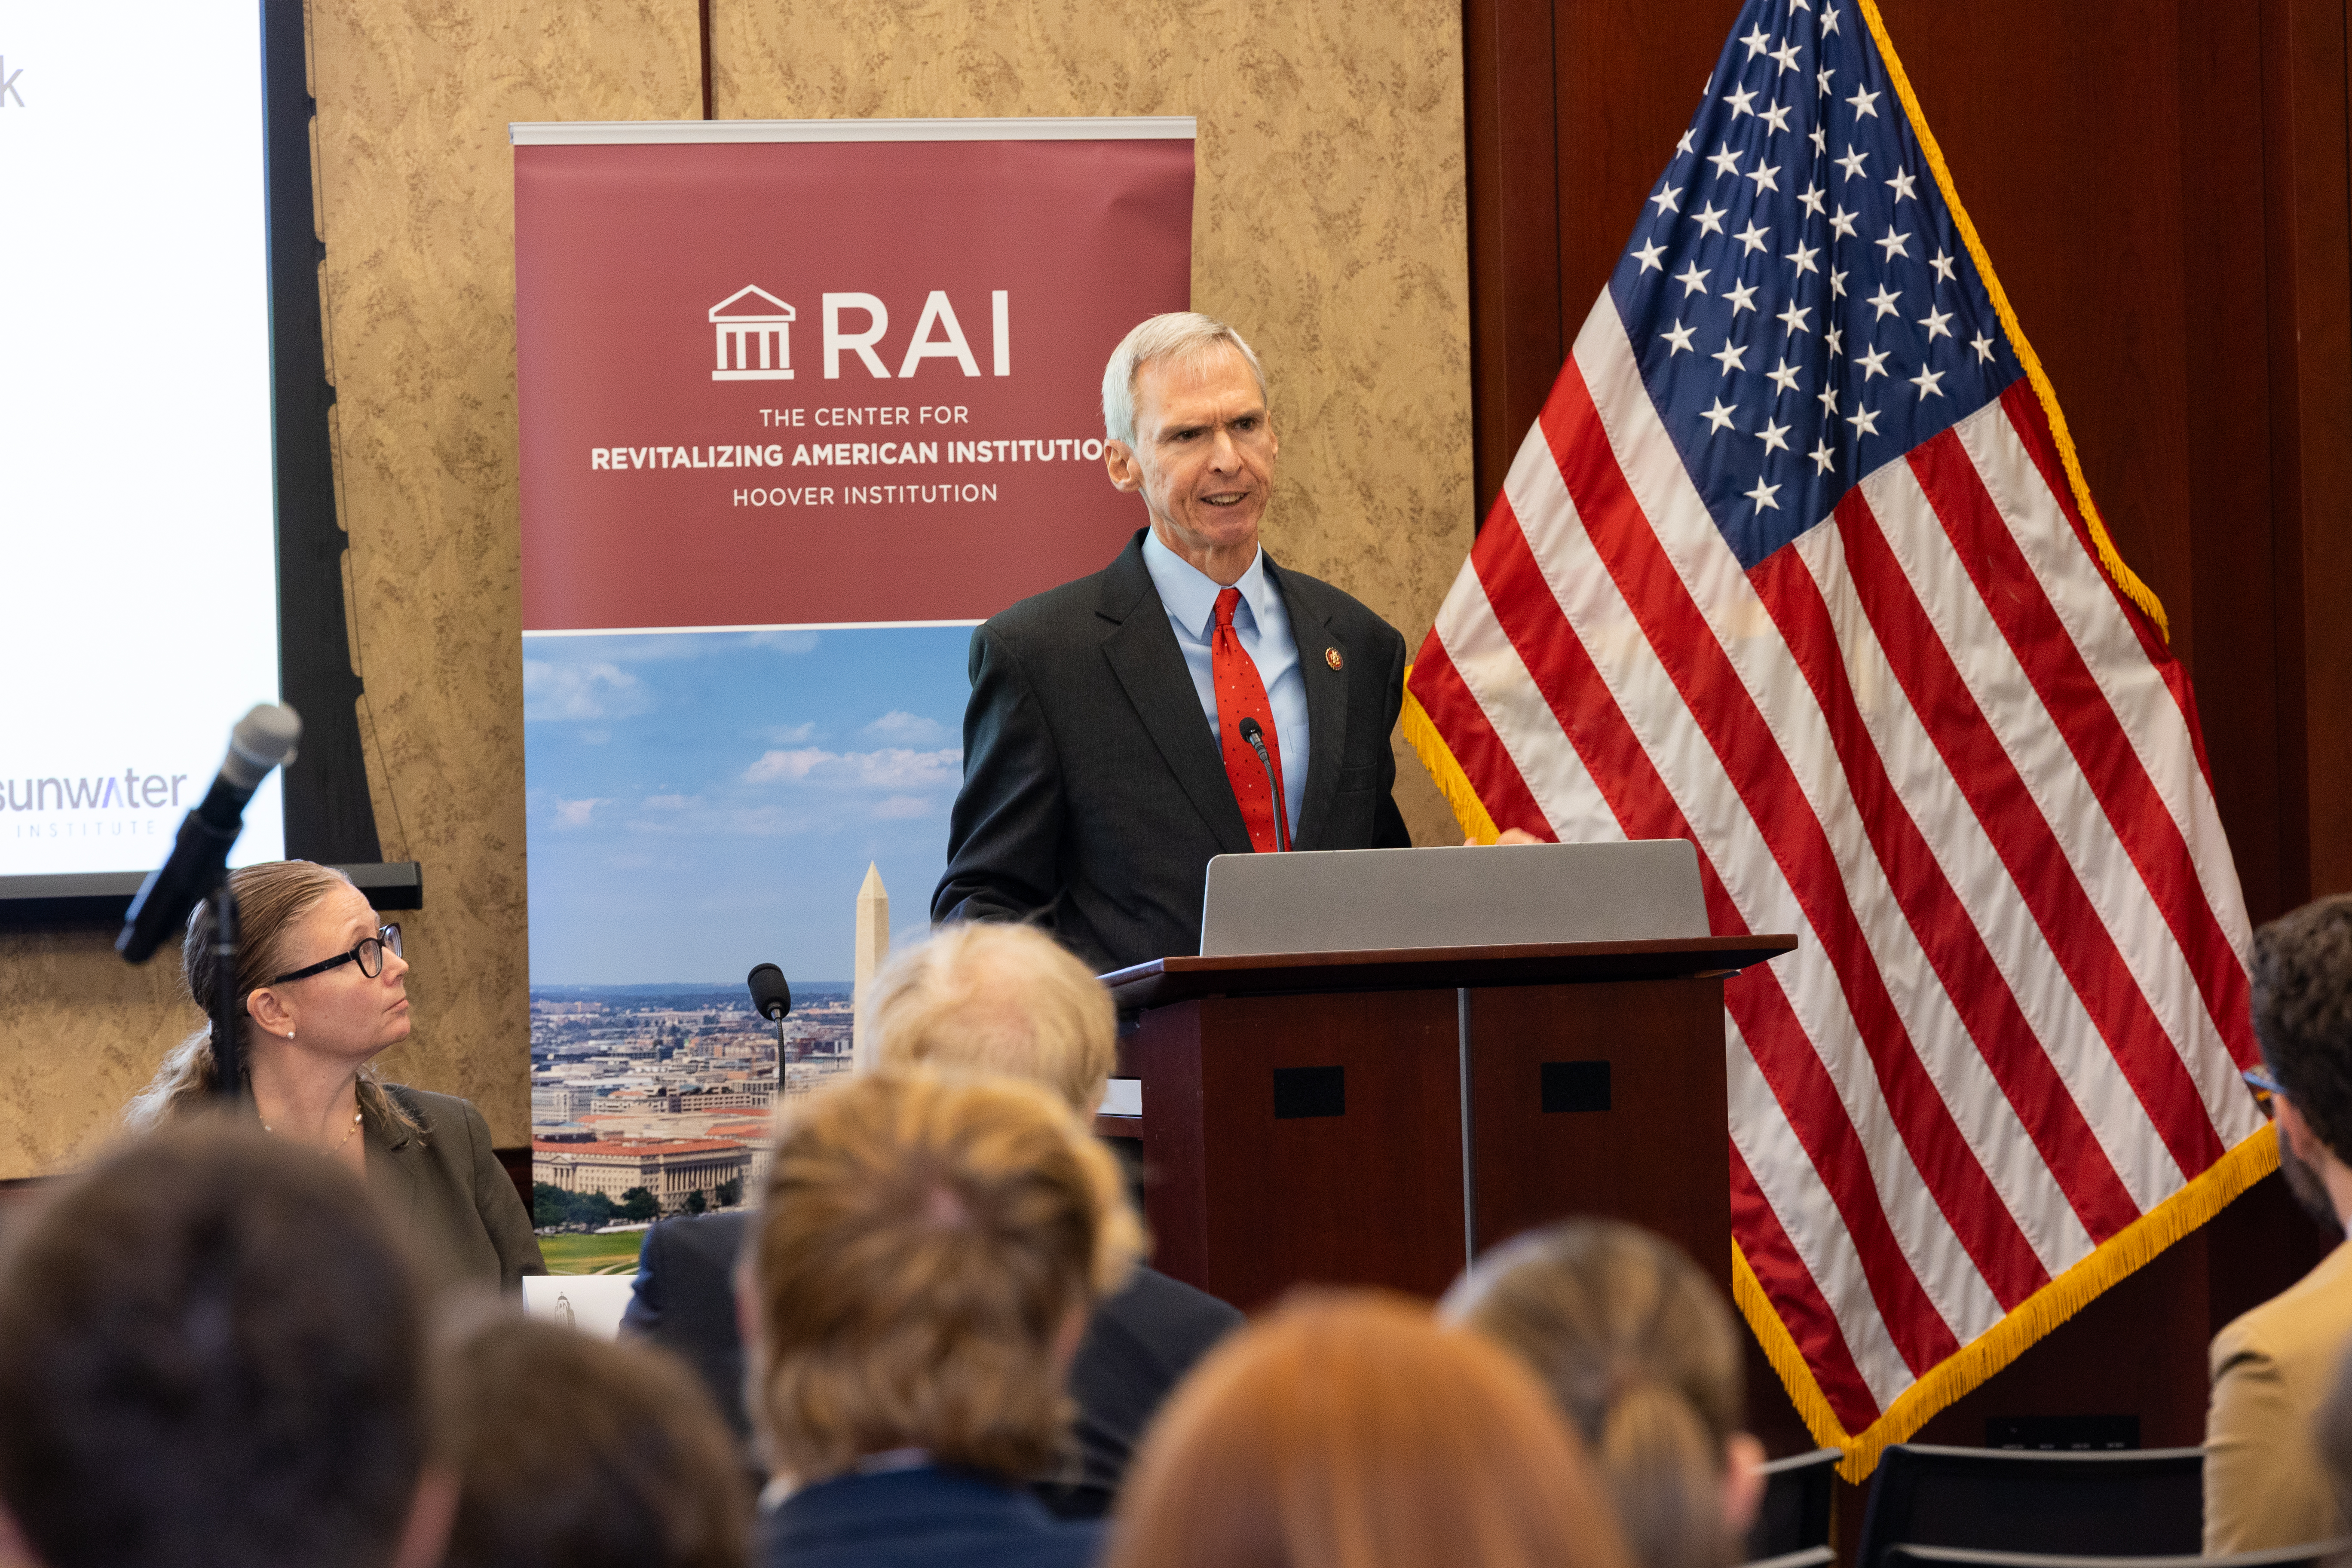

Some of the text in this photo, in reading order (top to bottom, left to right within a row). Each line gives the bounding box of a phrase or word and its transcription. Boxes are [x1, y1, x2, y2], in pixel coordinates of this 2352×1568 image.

[822, 290, 1011, 379] RAI
[759, 406, 968, 426] THE CENTER FOR
[591, 438, 1103, 470] REVITALIZING AMERICAN INSTITUTIO
[733, 483, 997, 506] HOOVER INSTITUTION
[0, 767, 188, 812] unwater
[17, 820, 154, 838] INSTITUTE
